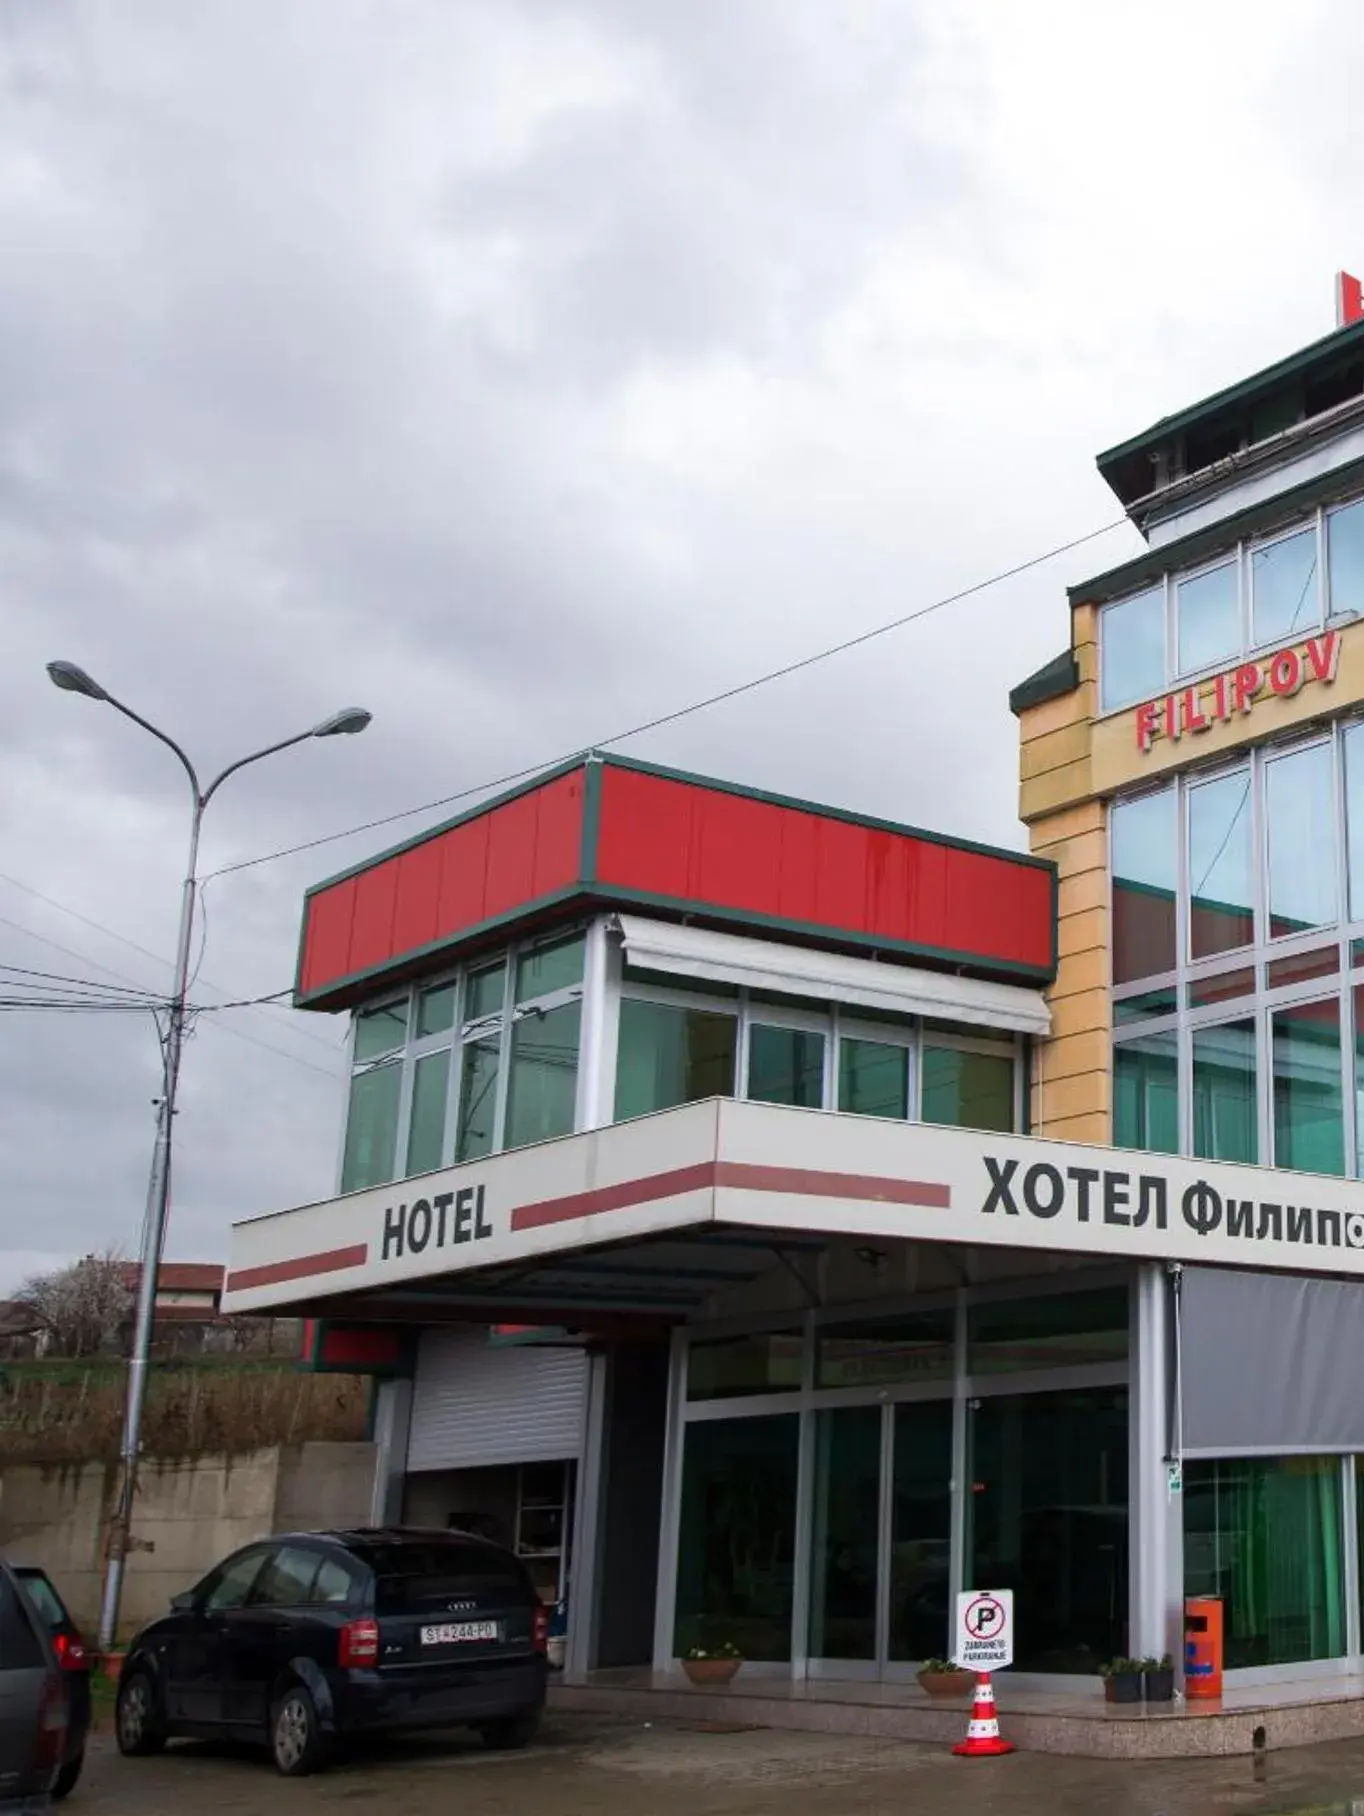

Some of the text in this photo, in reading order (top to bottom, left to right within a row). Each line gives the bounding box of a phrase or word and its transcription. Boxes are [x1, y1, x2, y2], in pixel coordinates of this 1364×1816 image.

[1136, 631, 1343, 754] FILIPOV
[381, 1184, 493, 1261] HOTEL
[981, 1156, 1168, 1230] ХОТЕЛ
[977, 1607, 996, 1632] P
